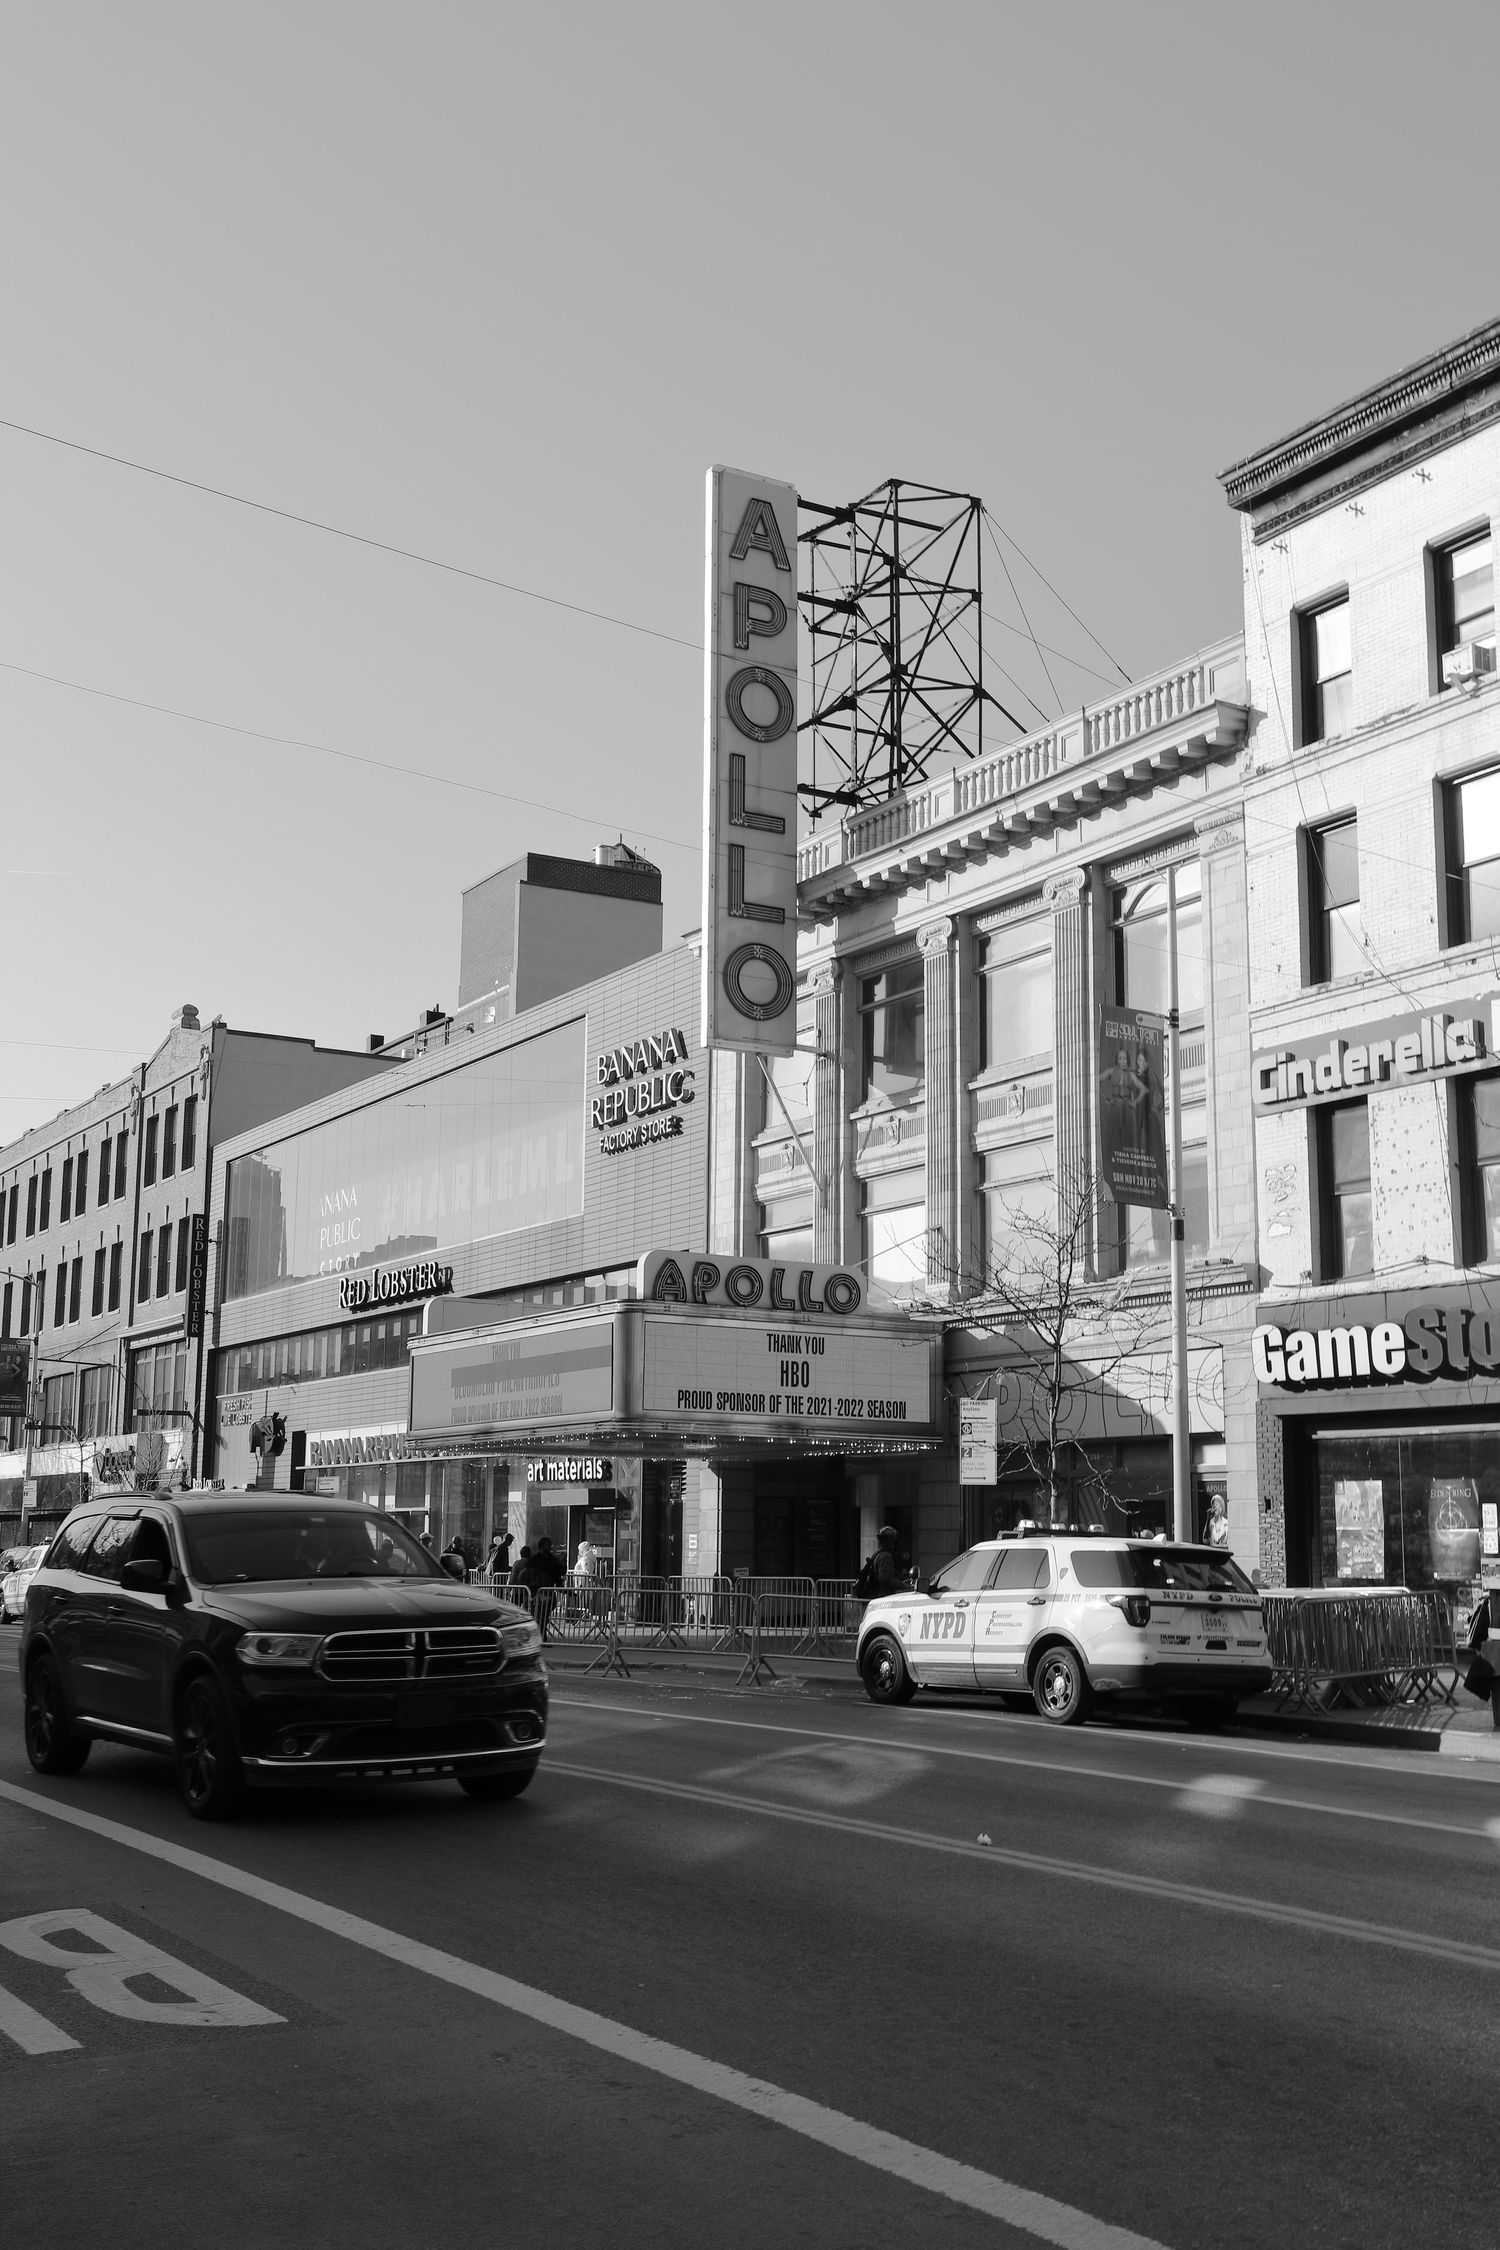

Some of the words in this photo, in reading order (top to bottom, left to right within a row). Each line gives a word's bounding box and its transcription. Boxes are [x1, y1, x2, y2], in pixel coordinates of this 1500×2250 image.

[723, 497, 794, 1021] APOLLO
[597, 1028, 682, 1084] BANANA
[1251, 1013, 1483, 1105] Cinderella
[591, 1069, 686, 1128] REPUBLIC
[600, 1125, 639, 1152] FACTORY
[641, 1115, 672, 1141] STORE
[195, 1218, 204, 1251] RED
[191, 1255, 203, 1333] LOBSTER
[338, 1277, 365, 1309] RED
[370, 1262, 438, 1302] LOBSTER
[653, 1257, 861, 1314] APOLLO
[766, 1333, 802, 1354] THANK
[804, 1336, 825, 1355] YOU
[780, 1360, 810, 1388] HBO
[491, 1402, 499, 1421] OF
[499, 1400, 509, 1420] THE
[677, 1389, 713, 1410] PROUD
[716, 1391, 765, 1413] SPONSOR
[769, 1394, 782, 1414] OF
[784, 1394, 804, 1415] THE
[807, 1396, 864, 1417] 2021-2022
[867, 1399, 907, 1420] SEASON
[310, 1437, 366, 1466] BANANA
[527, 1461, 544, 1482] art
[546, 1457, 603, 1481] materials
[1430, 1488, 1450, 1499] ELDEN
[1452, 1488, 1472, 1498] RING
[1162, 1590, 1194, 1601] NYPD
[1229, 1594, 1258, 1604] POLICE
[920, 1611, 966, 1640] NYPD
